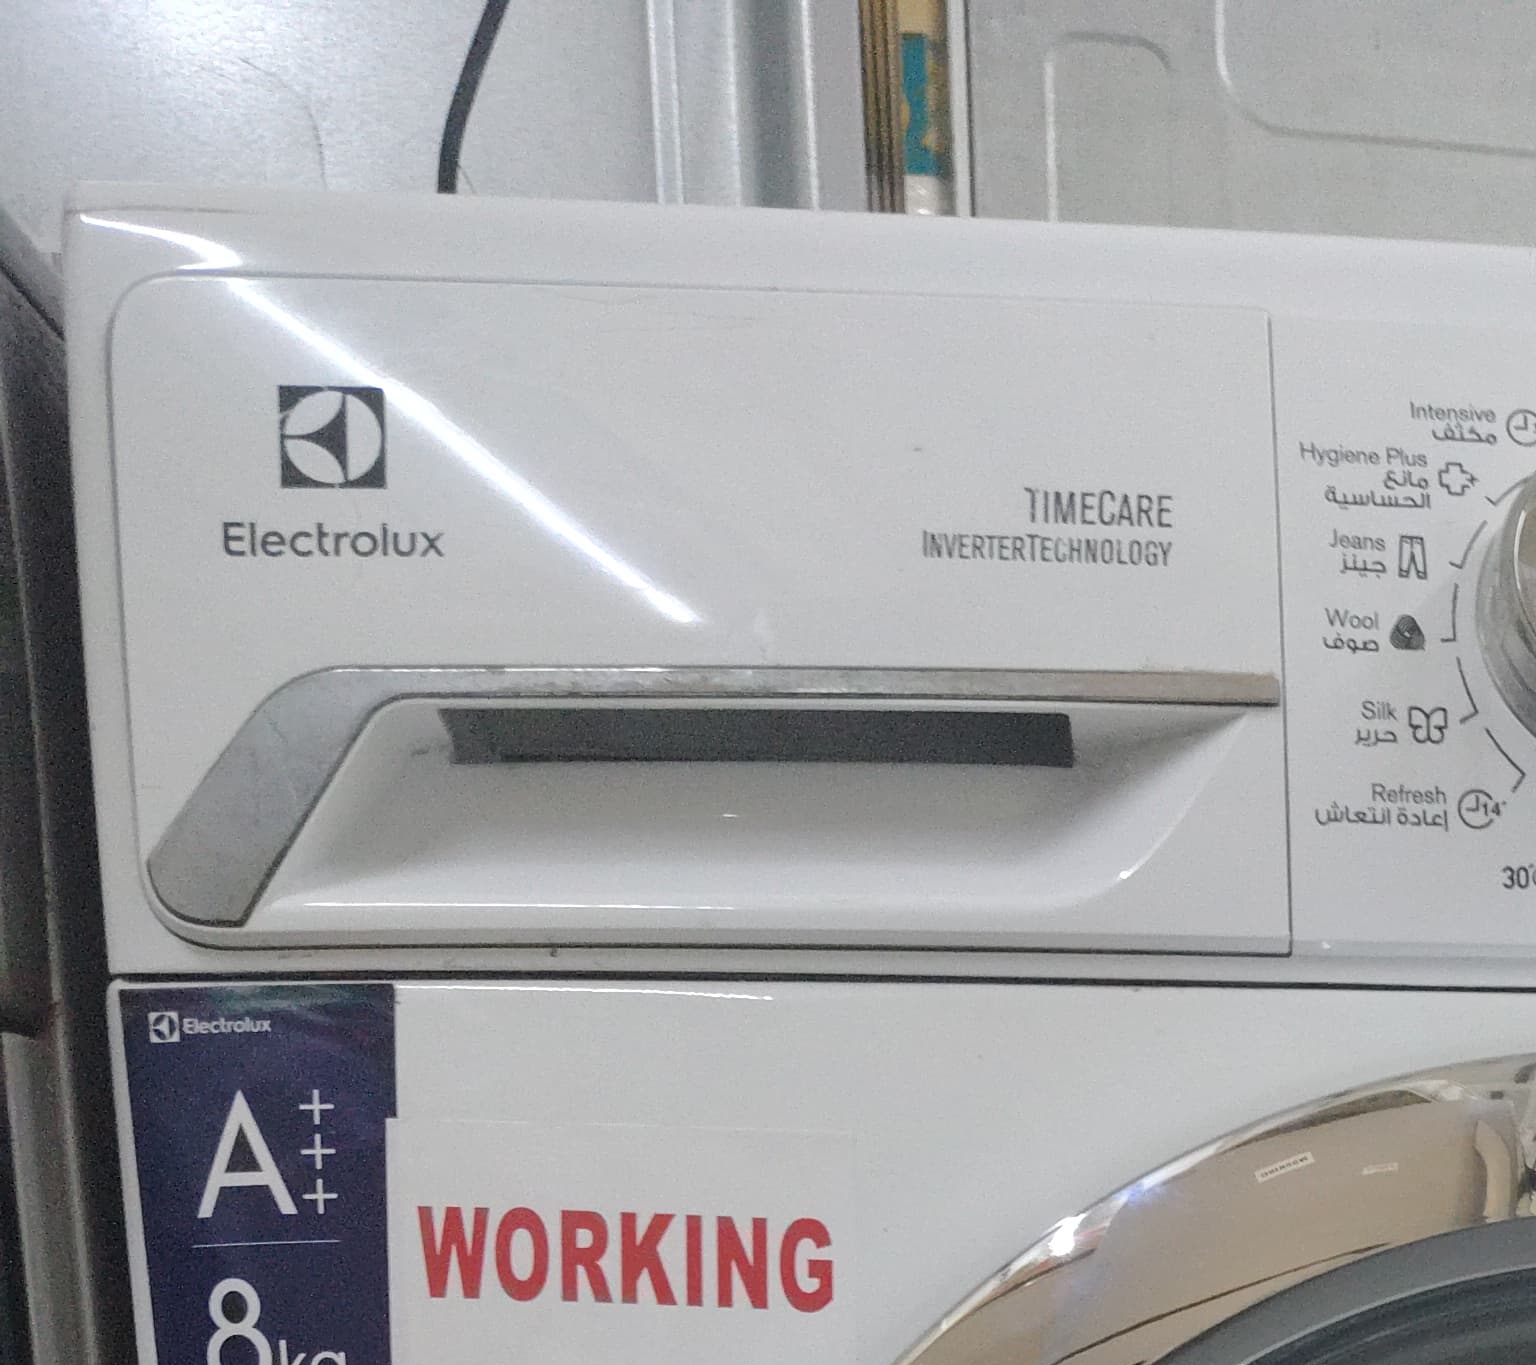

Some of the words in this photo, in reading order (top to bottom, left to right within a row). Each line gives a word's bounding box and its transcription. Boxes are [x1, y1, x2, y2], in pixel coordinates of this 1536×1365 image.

[1410, 401, 1496, 423] Intensive
[1299, 441, 1380, 467] Hygiene
[1386, 446, 1428, 467] Plus
[222, 521, 445, 560] Electrolux
[922, 530, 1172, 568] INVERTERTECHNOLOGY
[1328, 528, 1386, 551] Jeans
[1325, 607, 1380, 631] Wool
[1360, 701, 1398, 721] Silk
[1371, 783, 1446, 804] Refresh
[182, 1017, 271, 1035] Electrolux
[417, 1205, 833, 1313] WORKING
